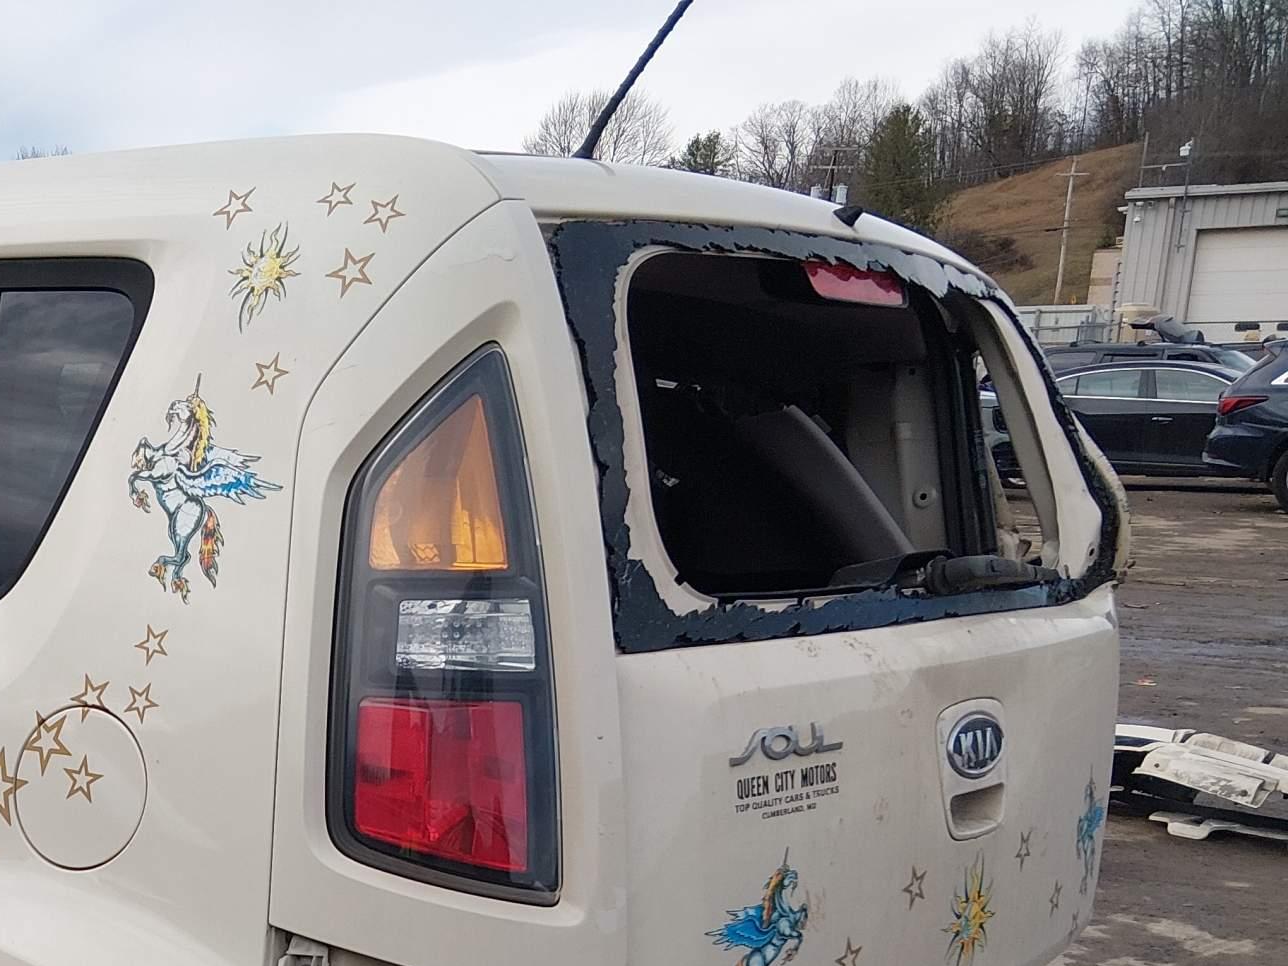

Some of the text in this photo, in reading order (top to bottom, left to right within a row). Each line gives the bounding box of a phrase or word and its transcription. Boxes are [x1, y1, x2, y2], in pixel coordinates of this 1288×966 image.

[729, 722, 843, 767] SOUL
[958, 727, 998, 769] KIA
[735, 785, 840, 814] TOP QUALITY CARS & TRUCKS
[736, 762, 838, 800] QUEEN CITY MOTORS
[806, 802, 817, 811] MD
